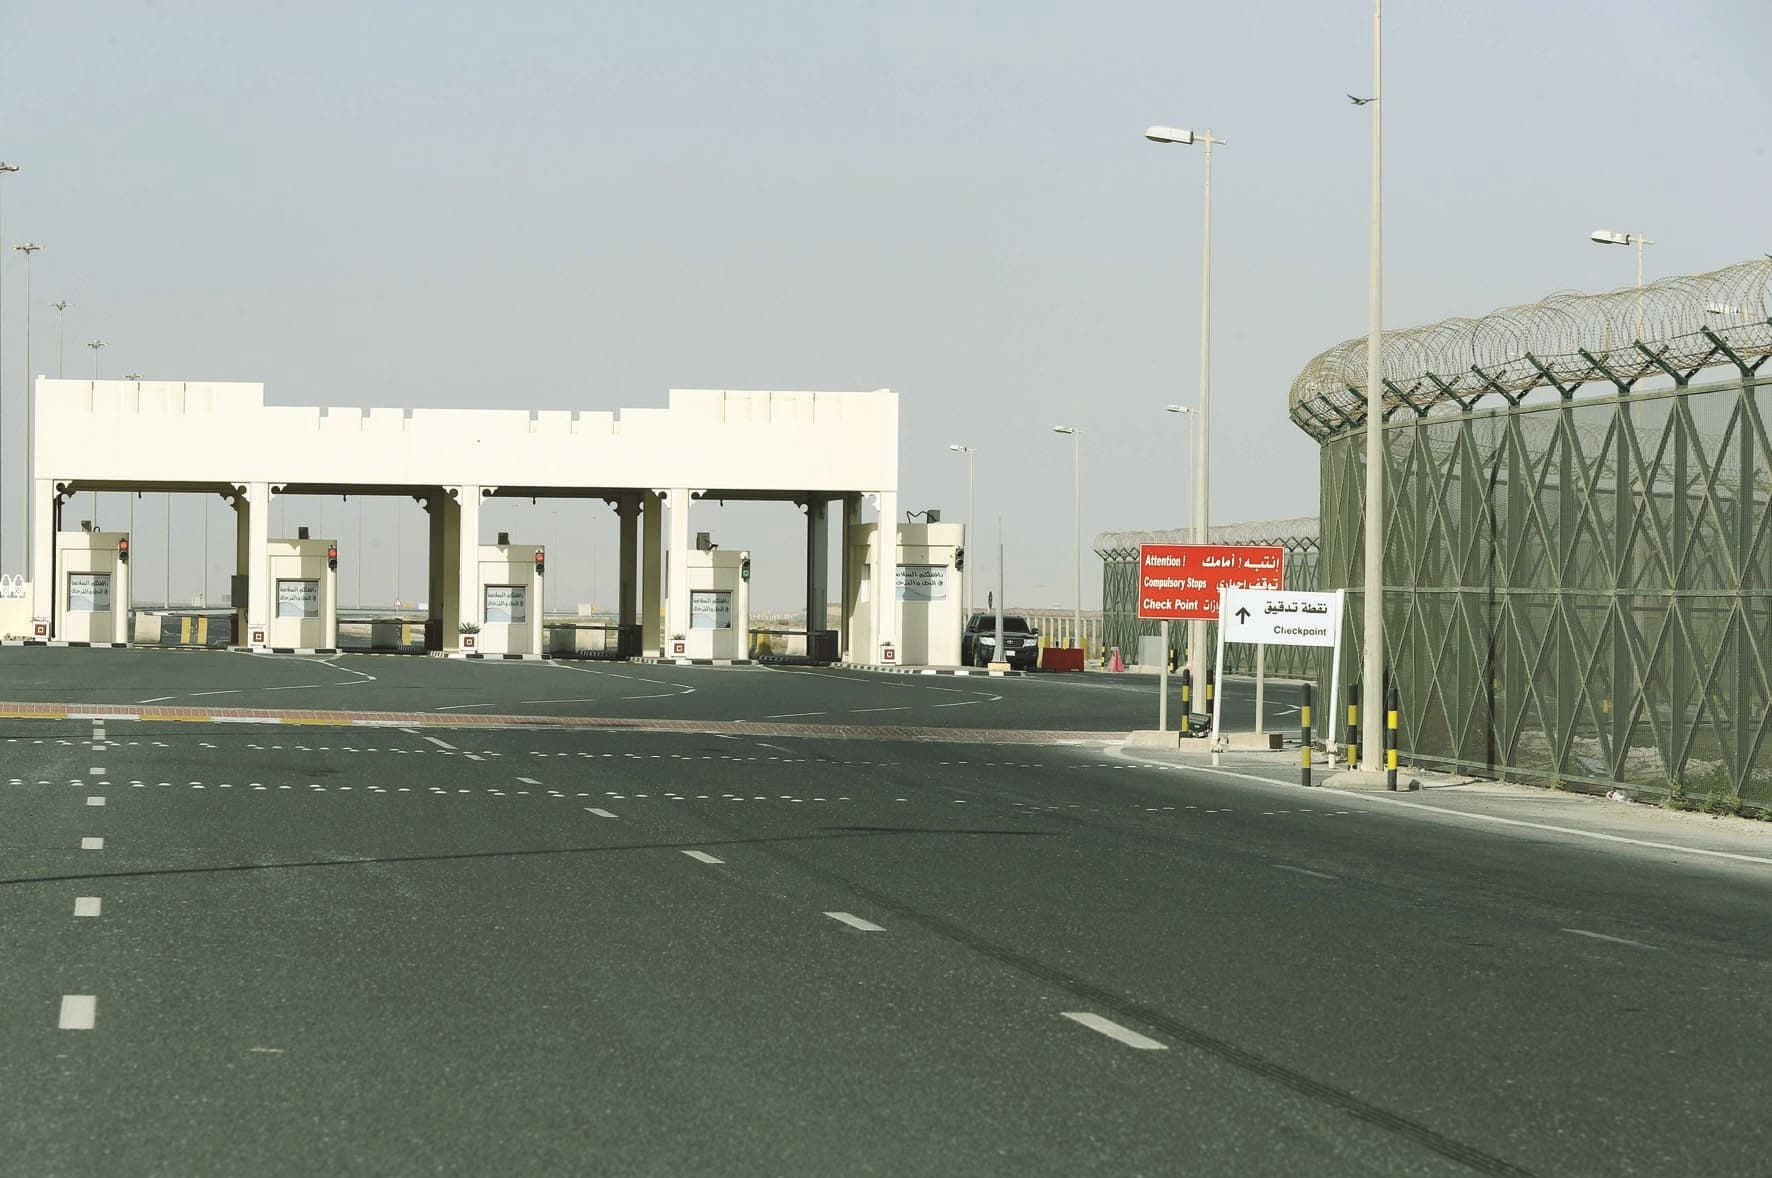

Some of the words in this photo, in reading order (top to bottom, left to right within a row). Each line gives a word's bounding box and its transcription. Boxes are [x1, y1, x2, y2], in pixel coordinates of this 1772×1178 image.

[1145, 554, 1181, 567] Attention
[1202, 554, 1235, 568] أمامك
[1144, 576, 1186, 591] Compulsory
[1187, 577, 1207, 591] Stops
[1144, 598, 1172, 610] Check
[1175, 599, 1199, 611] Point
[1264, 600, 1299, 615] تدقيق
[1302, 602, 1328, 614] نقطة
[1273, 625, 1327, 637] Checkpoint
